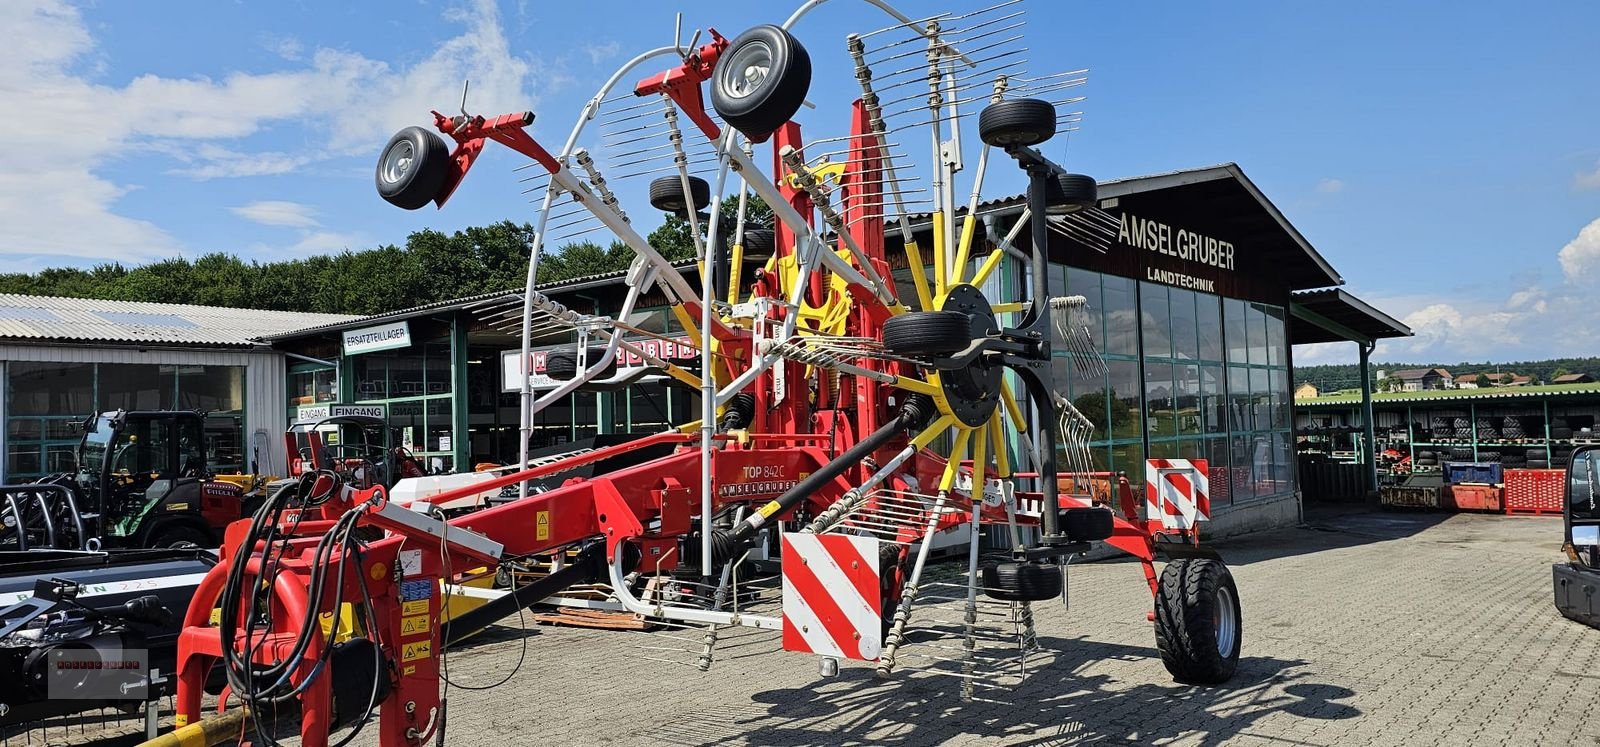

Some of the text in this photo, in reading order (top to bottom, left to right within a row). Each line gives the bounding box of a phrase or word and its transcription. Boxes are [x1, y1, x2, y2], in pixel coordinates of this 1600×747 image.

[1118, 212, 1235, 271] AMSELGRUBER
[1147, 266, 1215, 292] LANDTECHNIK
[346, 328, 405, 347] ERSATZTEILLAGER
[300, 409, 327, 420] EINGANG
[335, 407, 382, 417] EINGANG
[743, 466, 762, 479] TOP
[119, 580, 158, 591] 225
